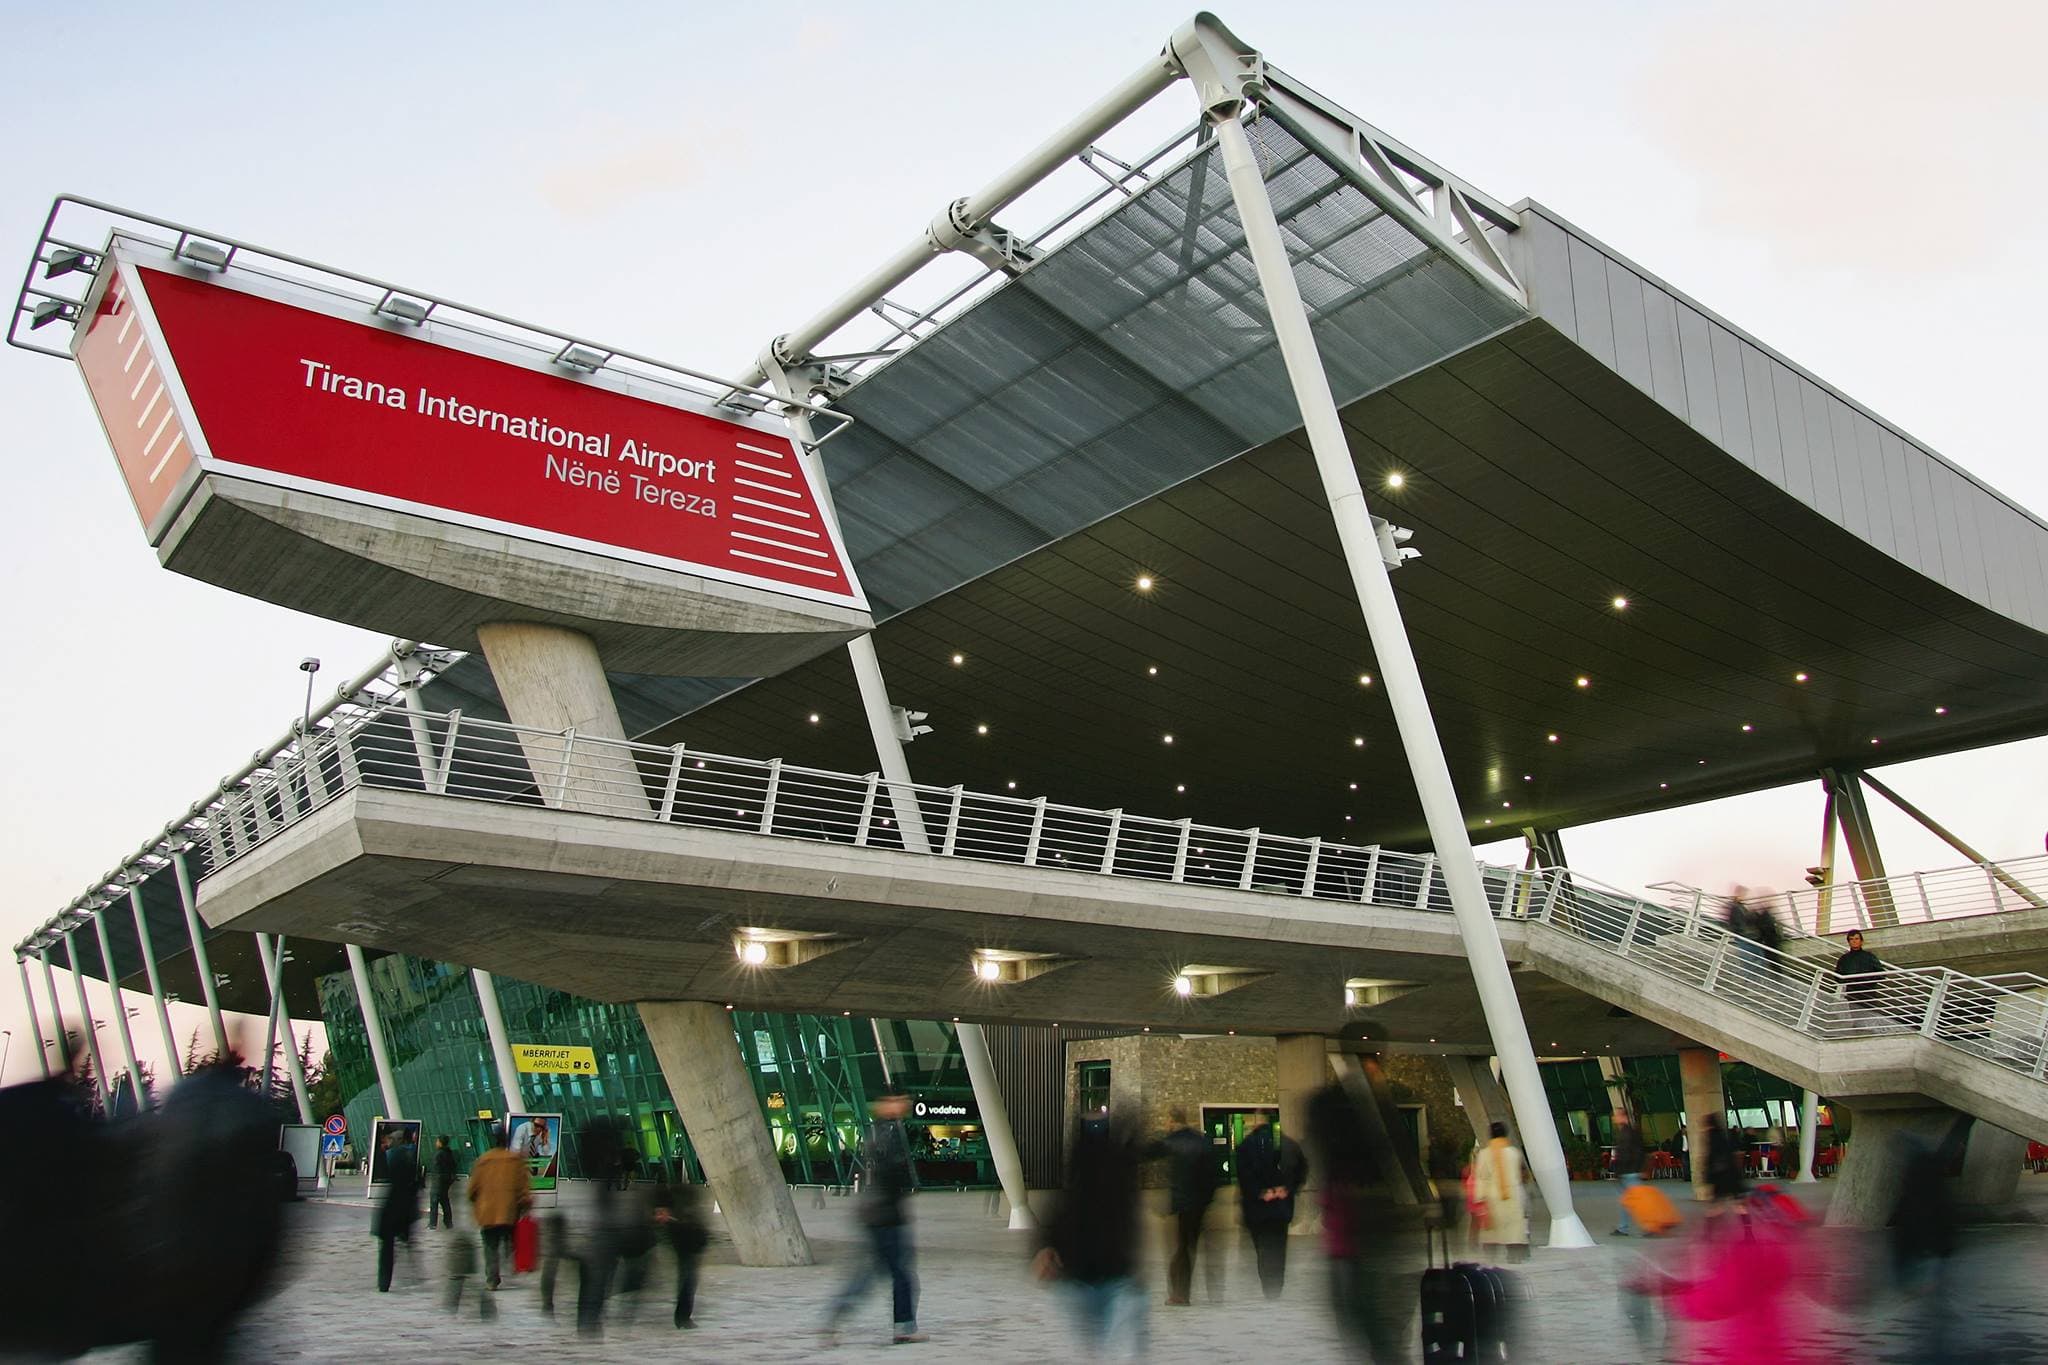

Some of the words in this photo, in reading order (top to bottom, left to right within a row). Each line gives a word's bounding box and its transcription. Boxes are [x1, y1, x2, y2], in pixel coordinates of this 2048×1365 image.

[299, 359, 407, 410] Tirana
[418, 388, 611, 458] International
[618, 439, 717, 484] Airport
[545, 454, 620, 495] Nënë
[629, 474, 717, 519] Tereza
[533, 1060, 570, 1069] ARRIVALS
[928, 1105, 967, 1115] vodafone
